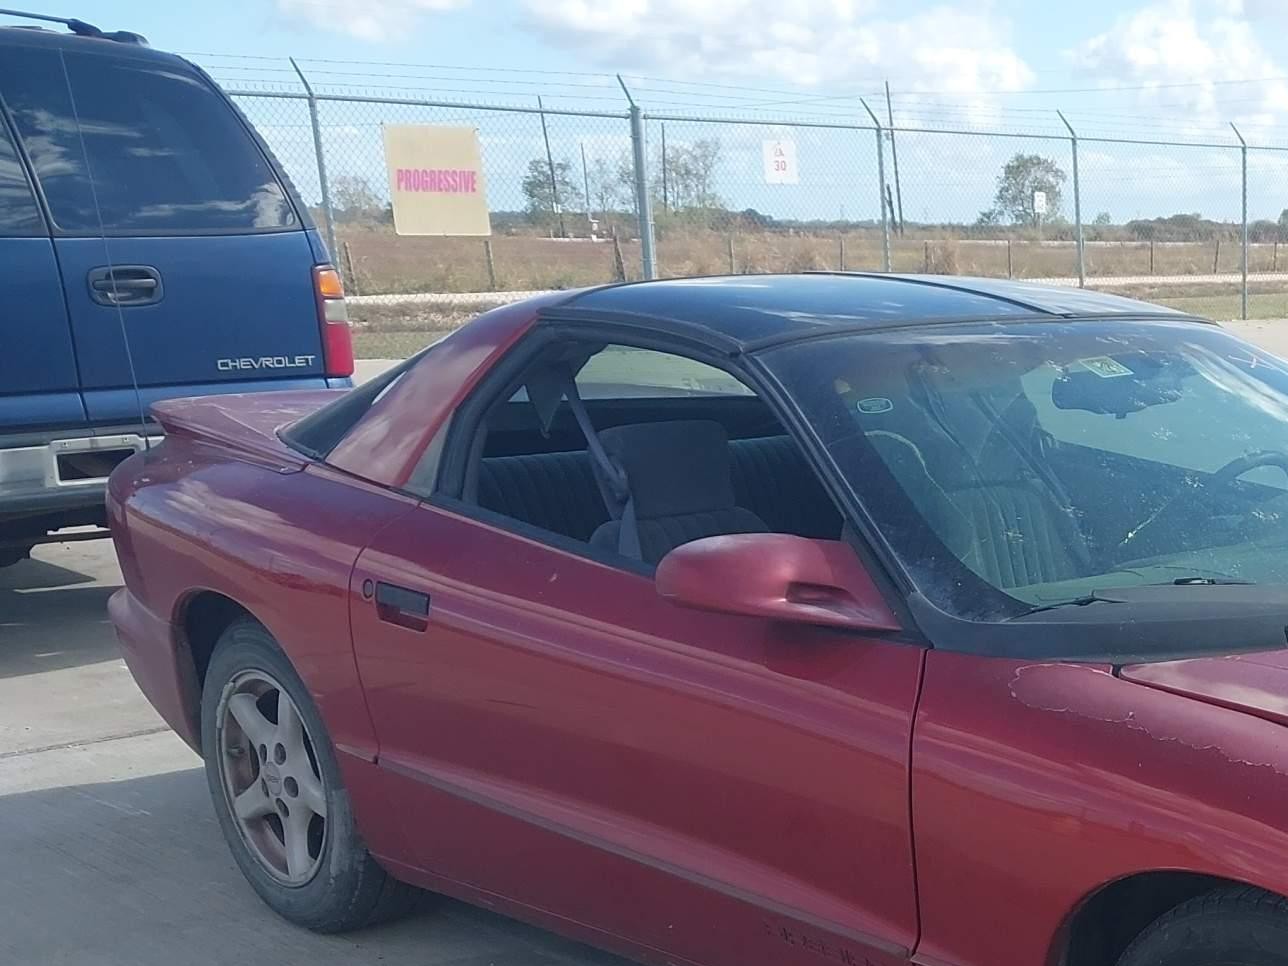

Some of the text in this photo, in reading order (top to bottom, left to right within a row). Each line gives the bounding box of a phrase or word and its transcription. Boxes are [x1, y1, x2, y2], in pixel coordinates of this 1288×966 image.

[774, 160, 787, 171] 30
[396, 168, 477, 193] PROGRESSIVE
[217, 355, 316, 370] CHEVROLET
